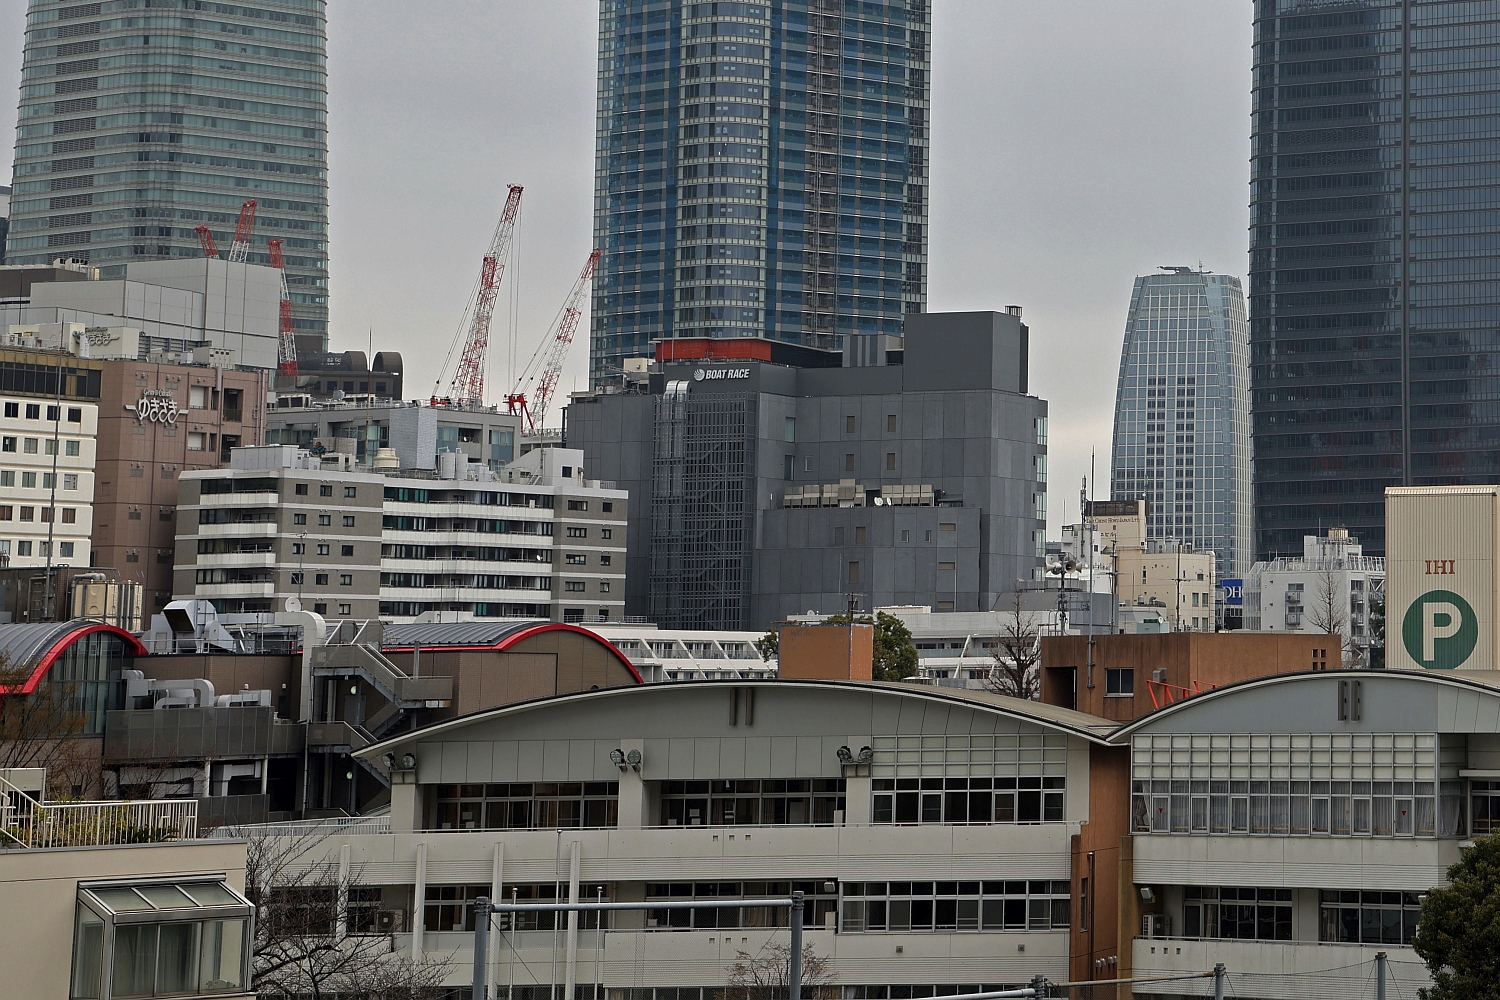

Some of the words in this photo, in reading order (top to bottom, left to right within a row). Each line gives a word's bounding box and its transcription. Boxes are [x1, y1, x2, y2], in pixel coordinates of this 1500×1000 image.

[705, 369, 727, 380] BOAT
[727, 368, 750, 379] RACE
[135, 396, 180, 423] ゆきざき
[1425, 560, 1455, 575] IHI
[1422, 601, 1462, 661] P
